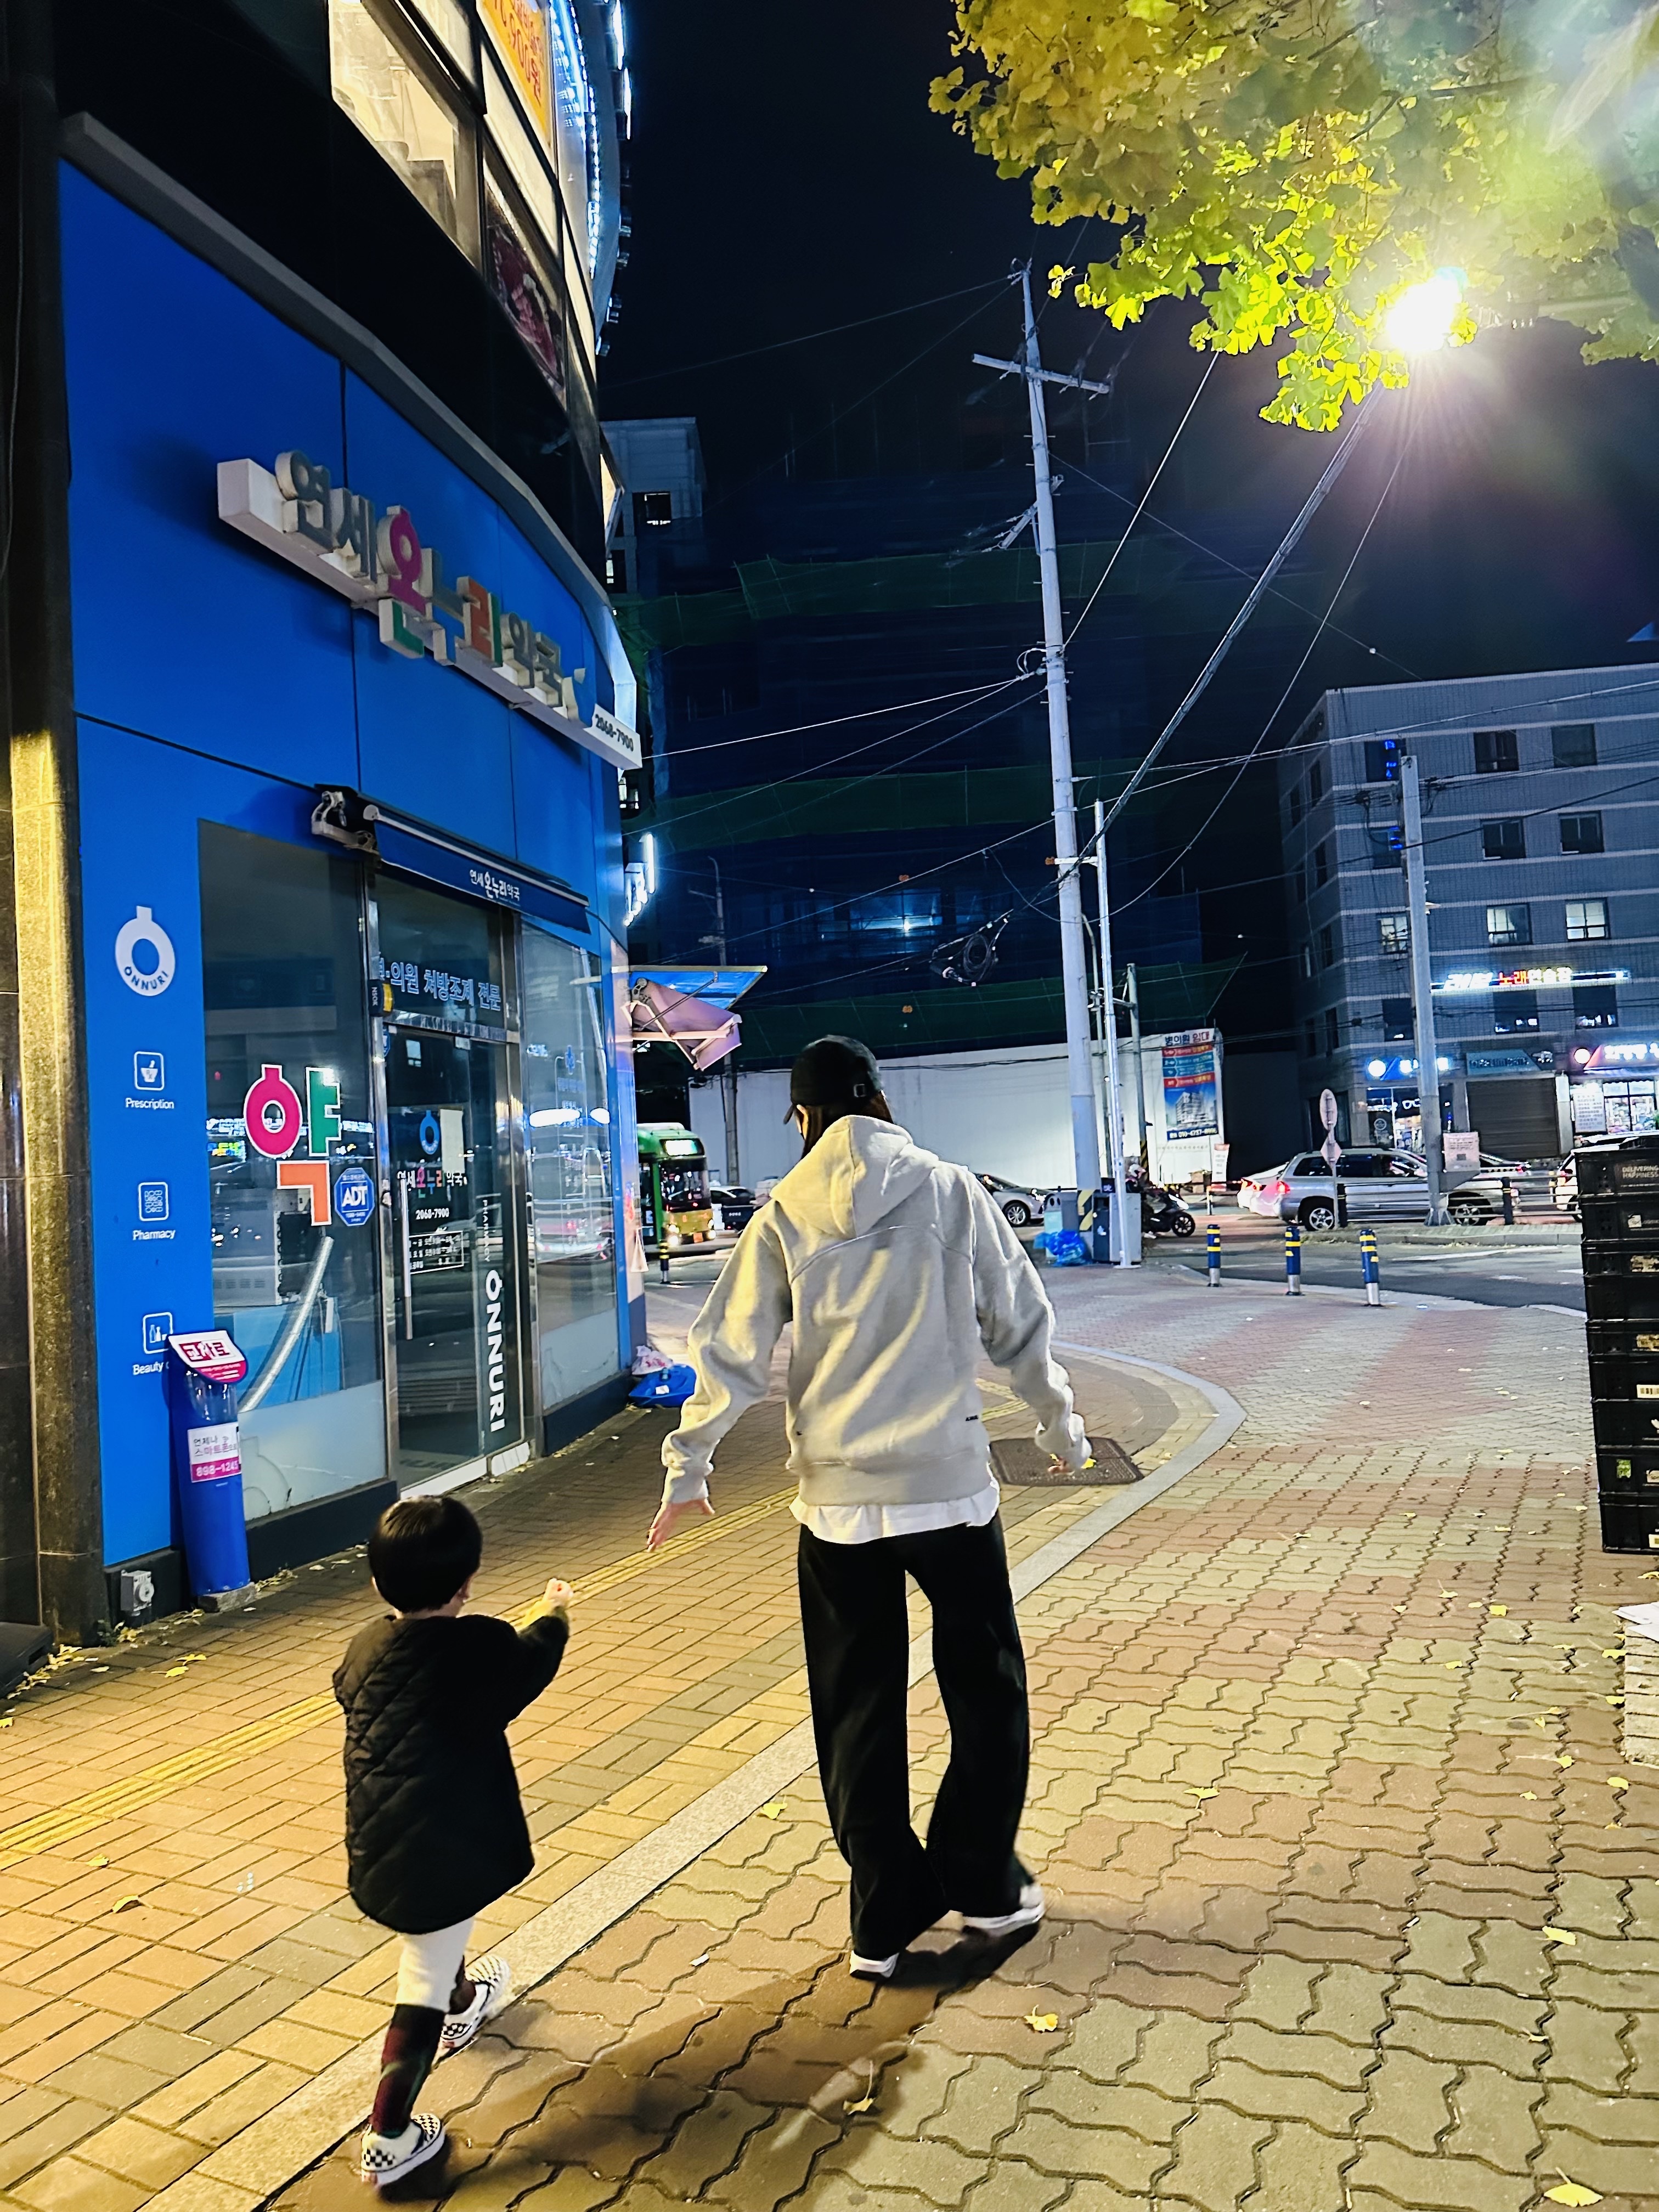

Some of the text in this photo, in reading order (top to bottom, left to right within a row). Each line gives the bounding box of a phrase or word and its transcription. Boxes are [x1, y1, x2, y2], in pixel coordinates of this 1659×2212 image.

[274, 449, 563, 709] 연세온누리약국
[595, 714, 634, 752] 2068-7900
[469, 869, 520, 901] 연세온누리약국
[123, 966, 168, 990] ONNURI
[423, 969, 473, 1006] 처방조제
[478, 981, 501, 1011] 전문
[1193, 1031, 1210, 1042] 임대
[125, 1097, 174, 1110] Prescription
[342, 1186, 368, 1207] ADT
[415, 1207, 449, 1220] 2068-7900
[132, 1229, 176, 1240] Pharmacy
[485, 1269, 506, 1432] ONNURI
[132, 1362, 163, 1375] Beauty
[194, 1435, 218, 1447] 언제나
